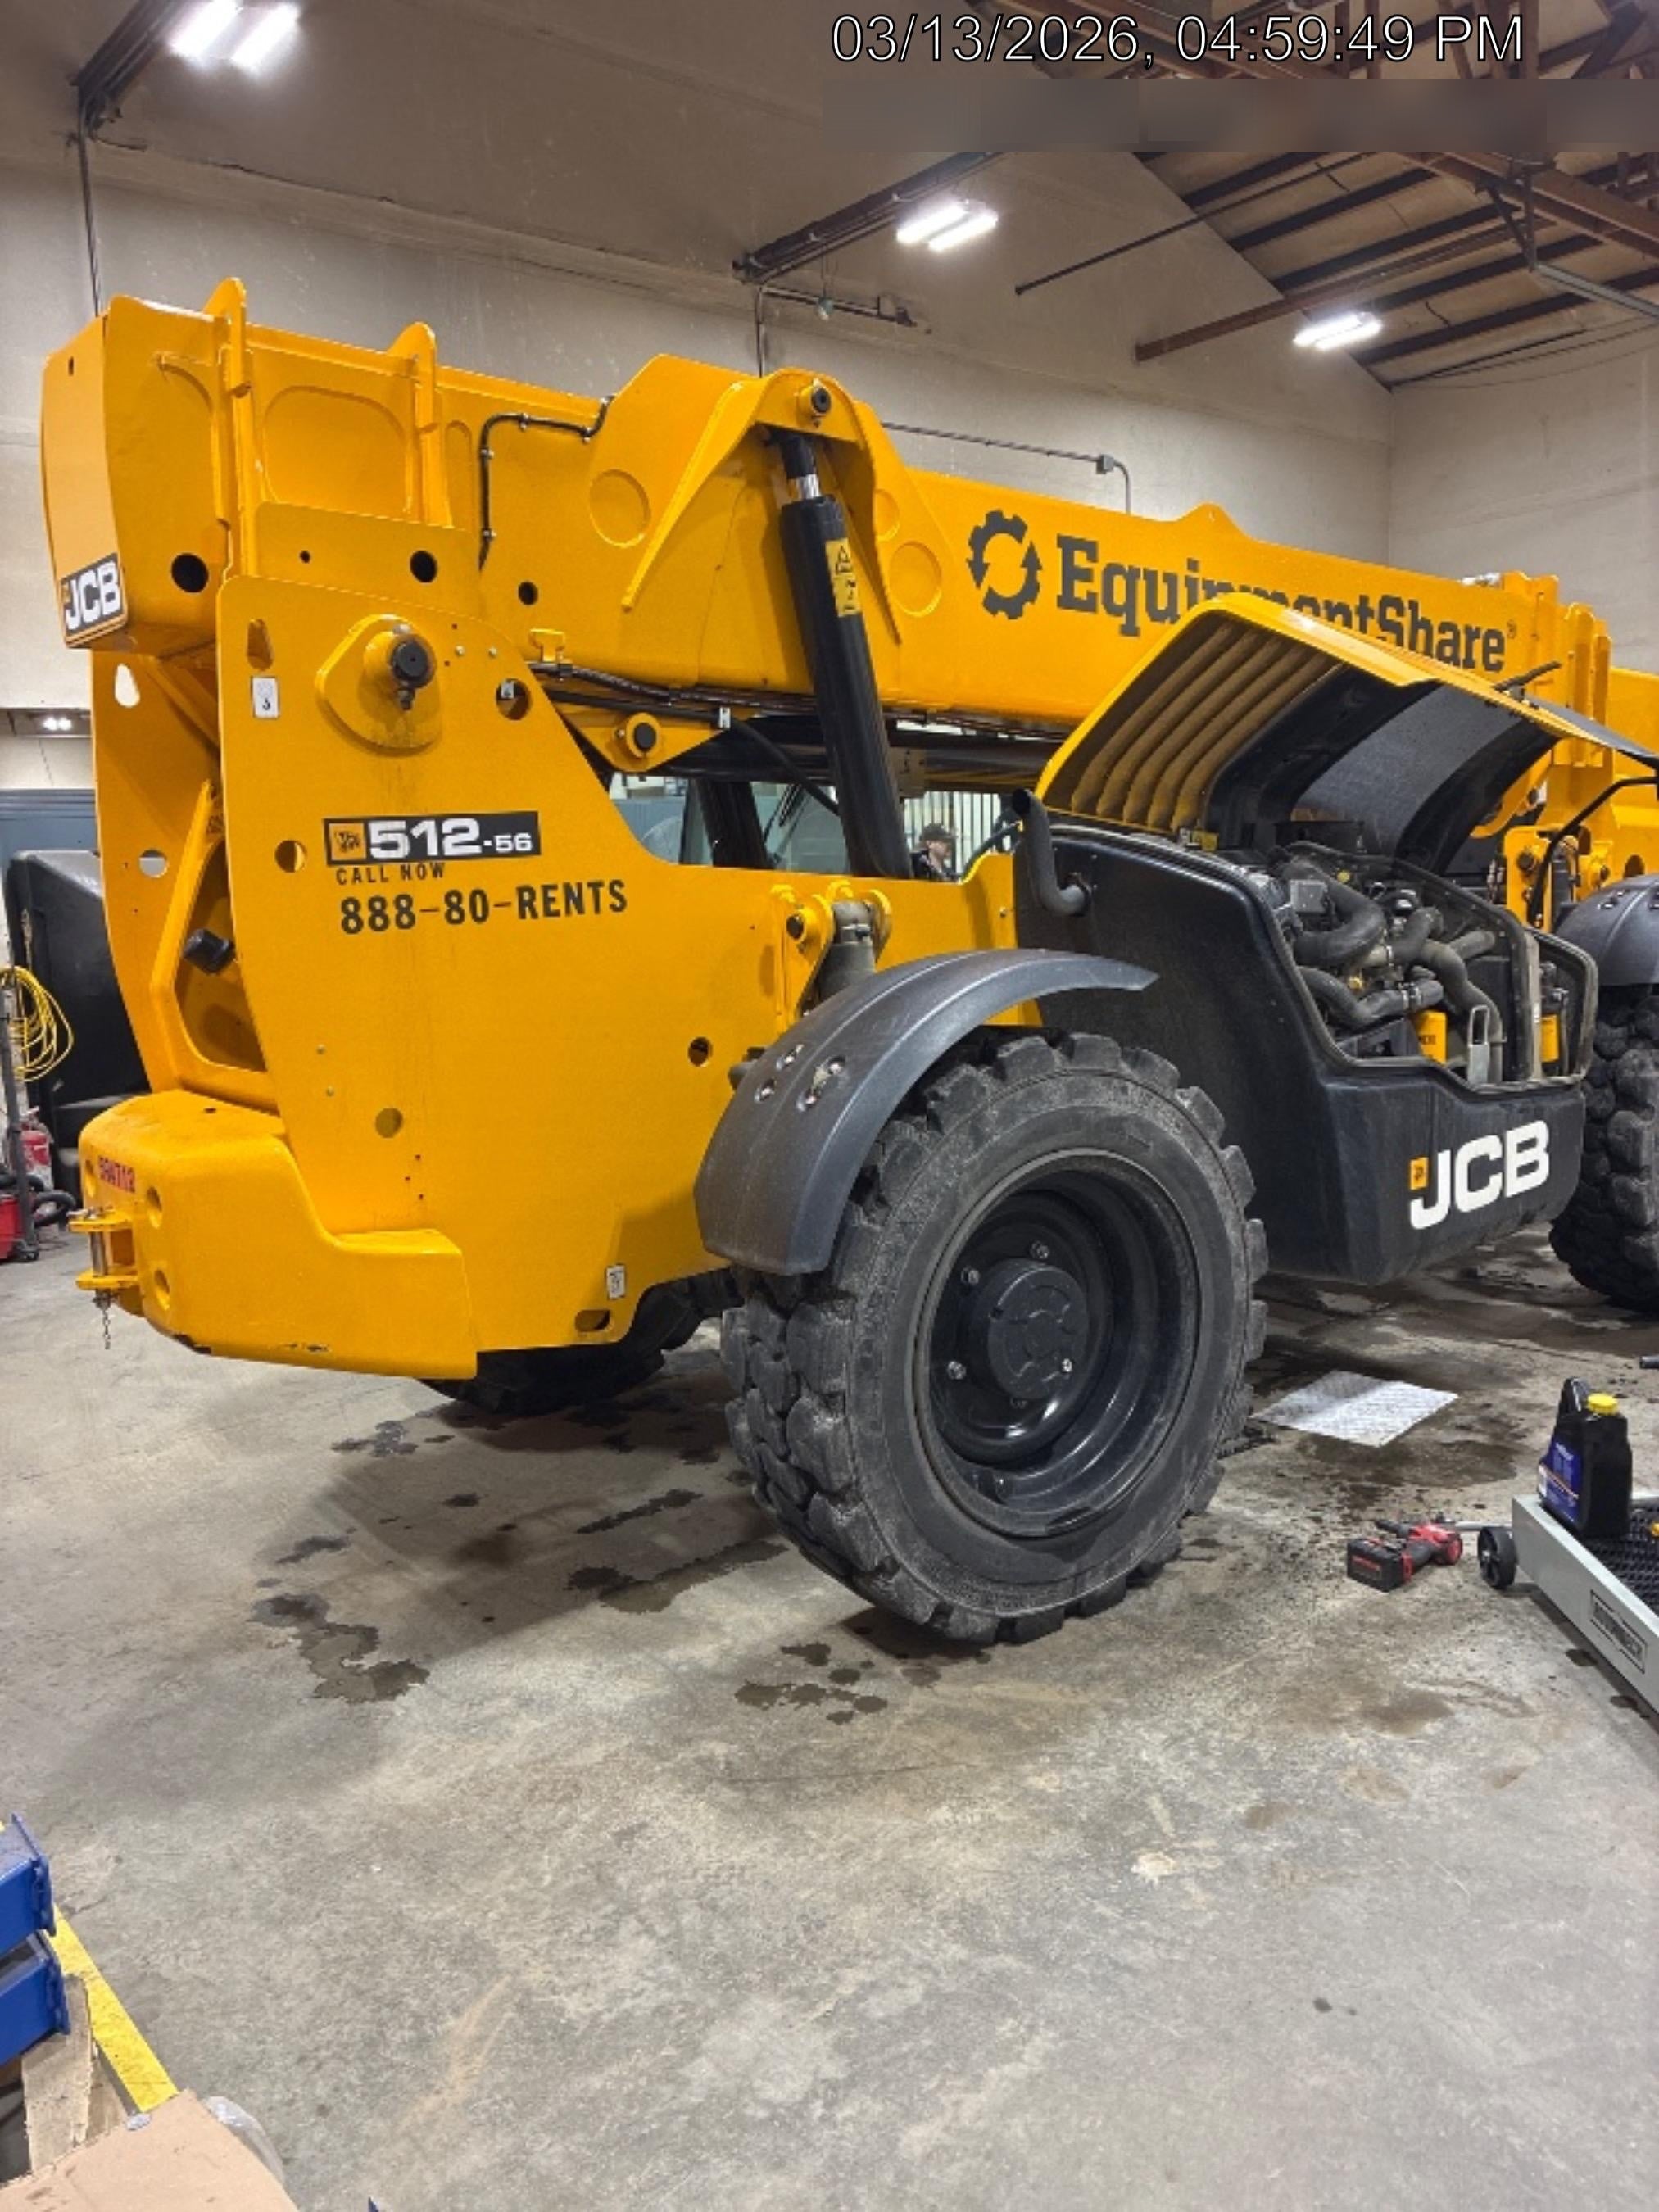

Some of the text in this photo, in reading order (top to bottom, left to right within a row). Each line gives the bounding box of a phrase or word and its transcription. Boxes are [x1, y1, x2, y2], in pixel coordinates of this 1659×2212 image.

[65, 560, 122, 631] JCB
[336, 862, 446, 886] CALL NOW
[340, 879, 628, 935] 888-80-RENTS
[1410, 1119, 1550, 1230] JCB
